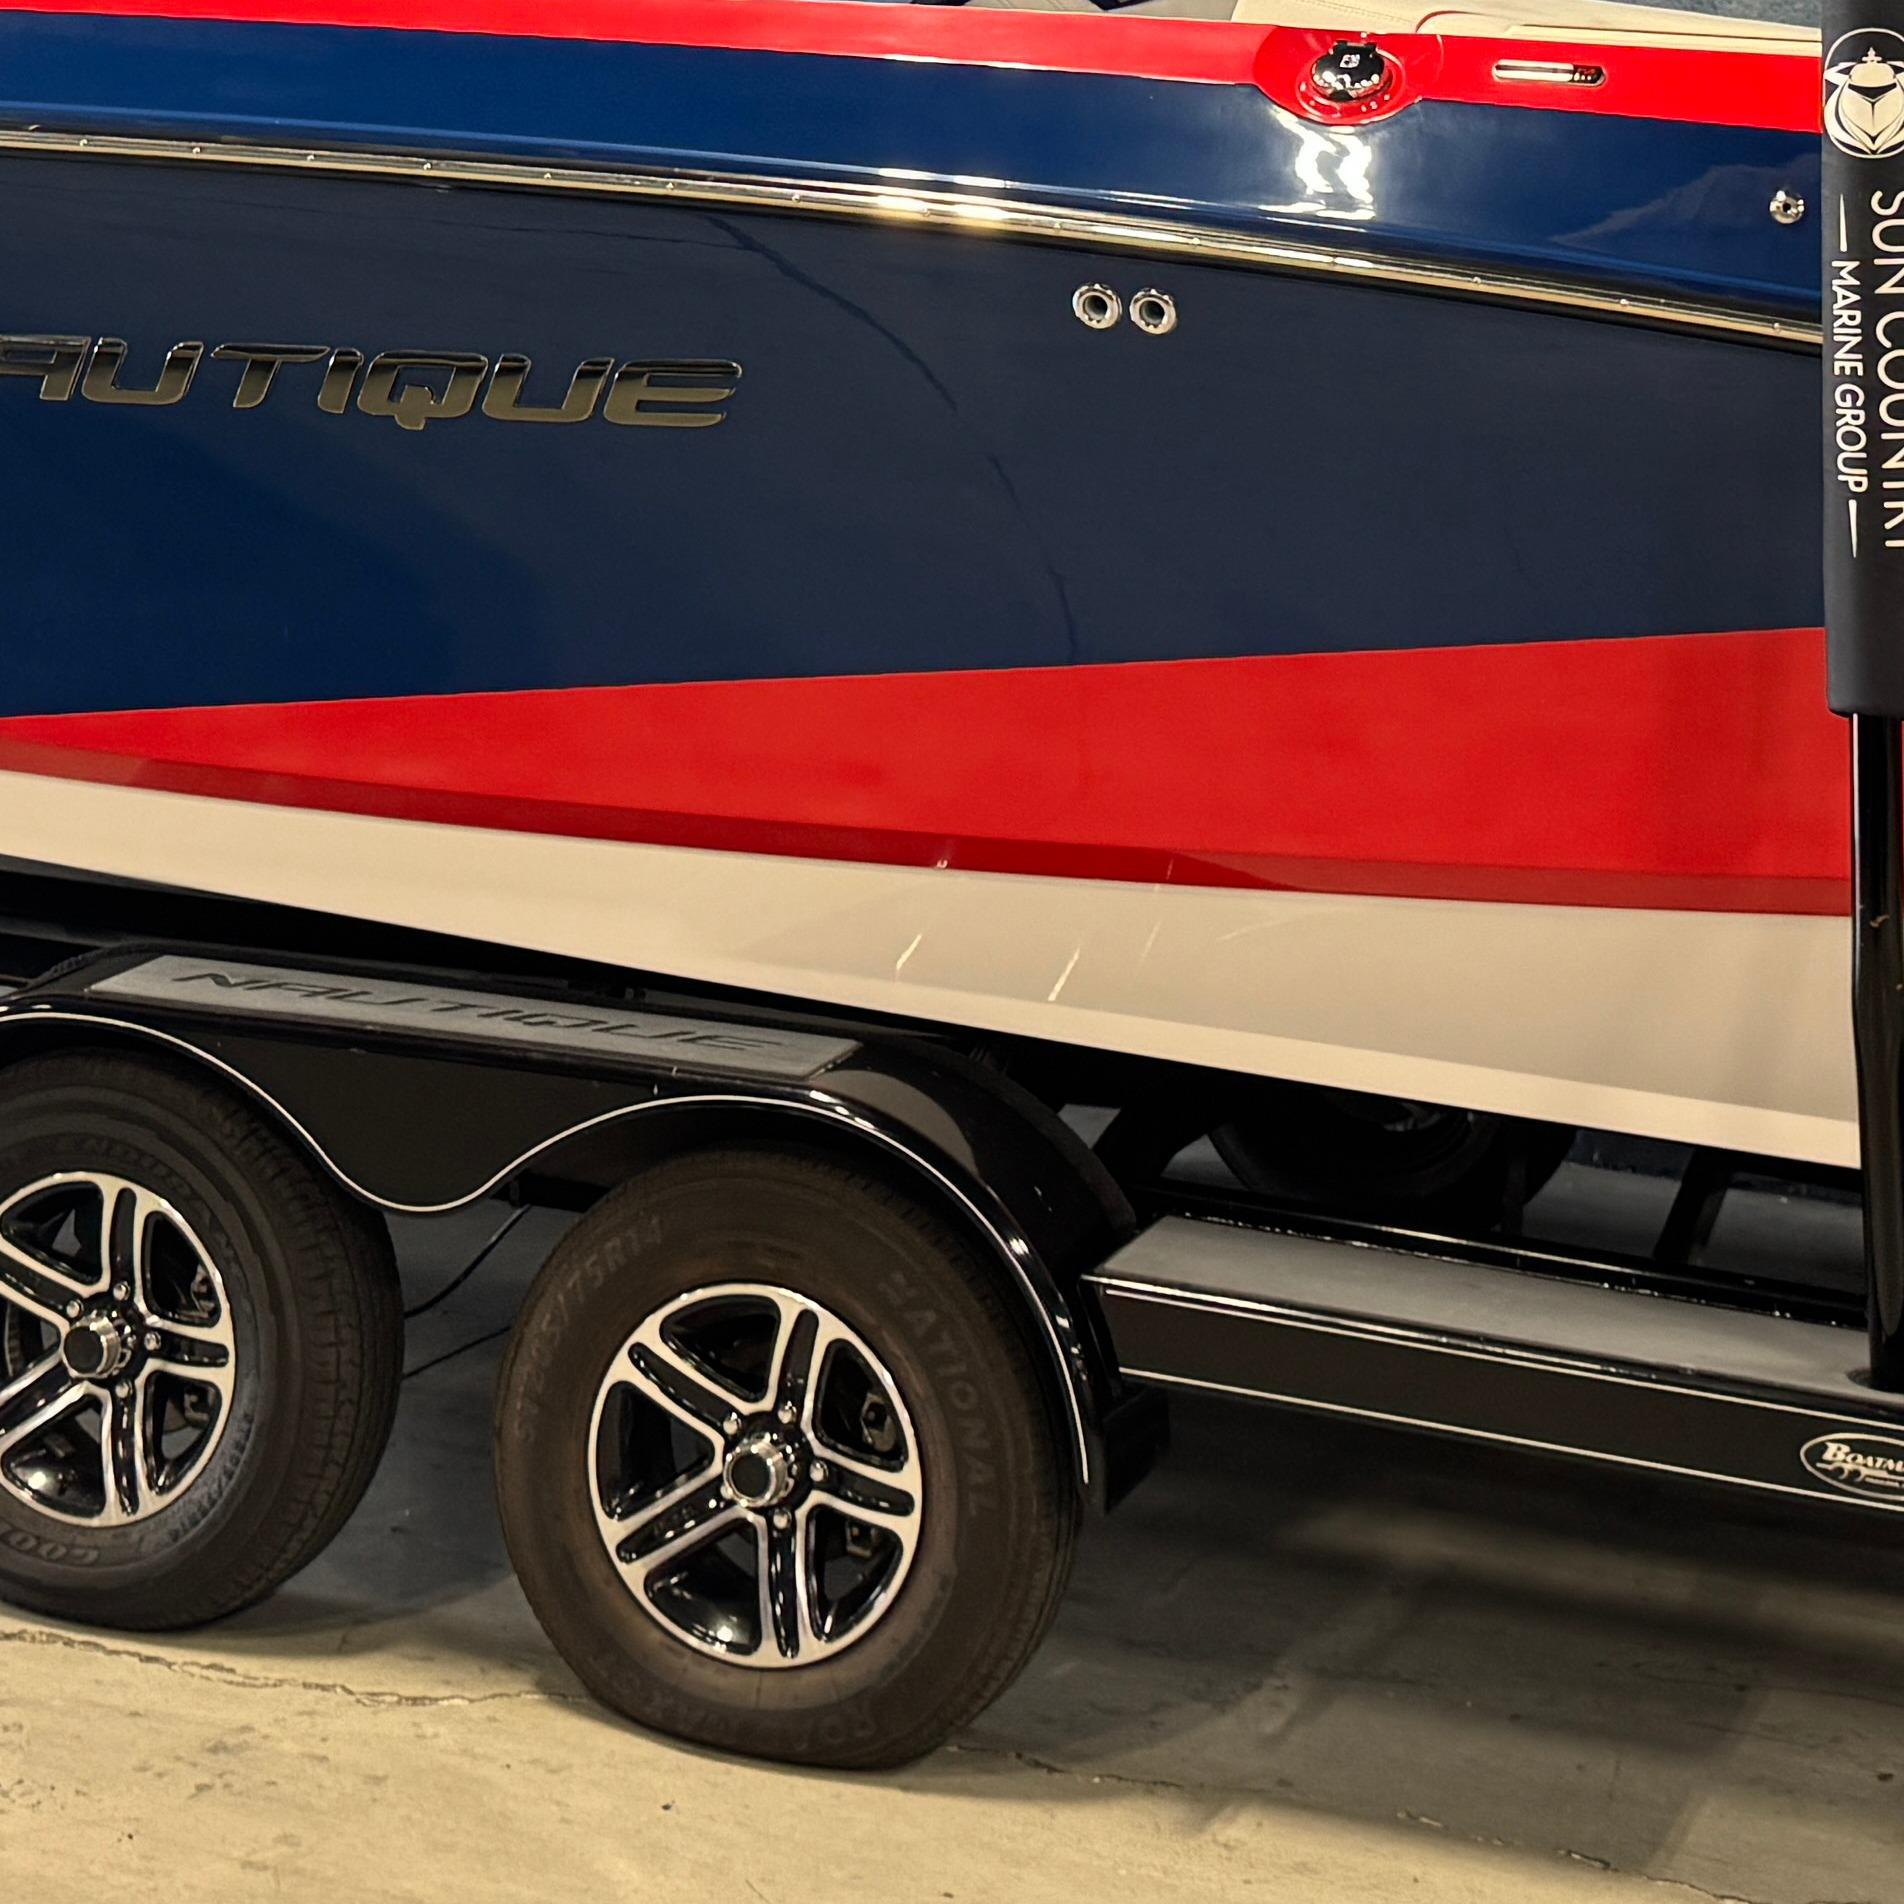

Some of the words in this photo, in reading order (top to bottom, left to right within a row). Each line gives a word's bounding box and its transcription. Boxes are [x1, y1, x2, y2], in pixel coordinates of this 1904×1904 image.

[1831, 260, 1864, 377] MARINE
[1835, 383, 1869, 493] GROUP
[171, 971, 794, 1053] NAUTIQUE
[873, 1262, 995, 1520] NATIONAL
